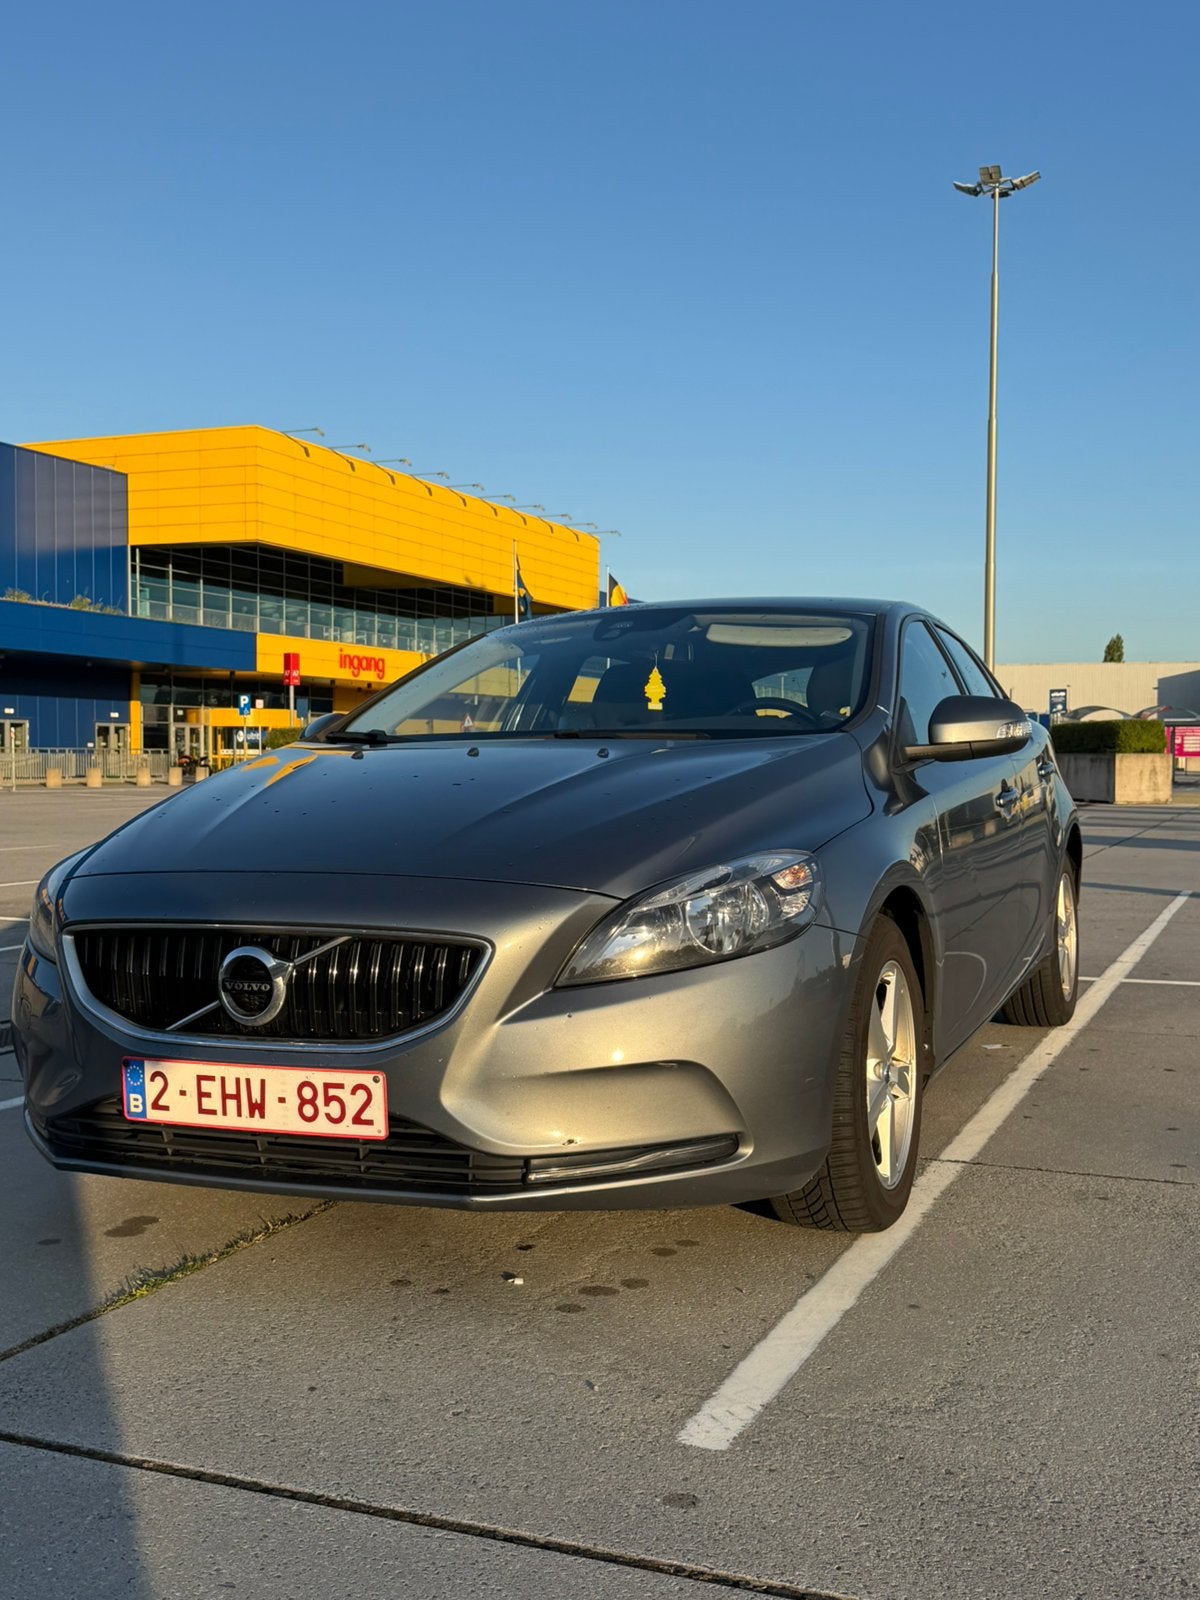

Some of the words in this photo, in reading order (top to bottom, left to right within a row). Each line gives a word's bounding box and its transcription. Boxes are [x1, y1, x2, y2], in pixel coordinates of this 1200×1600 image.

[339, 647, 385, 680] ingang
[240, 695, 249, 708] P
[225, 982, 271, 991] VOLVO
[129, 1093, 143, 1112] B
